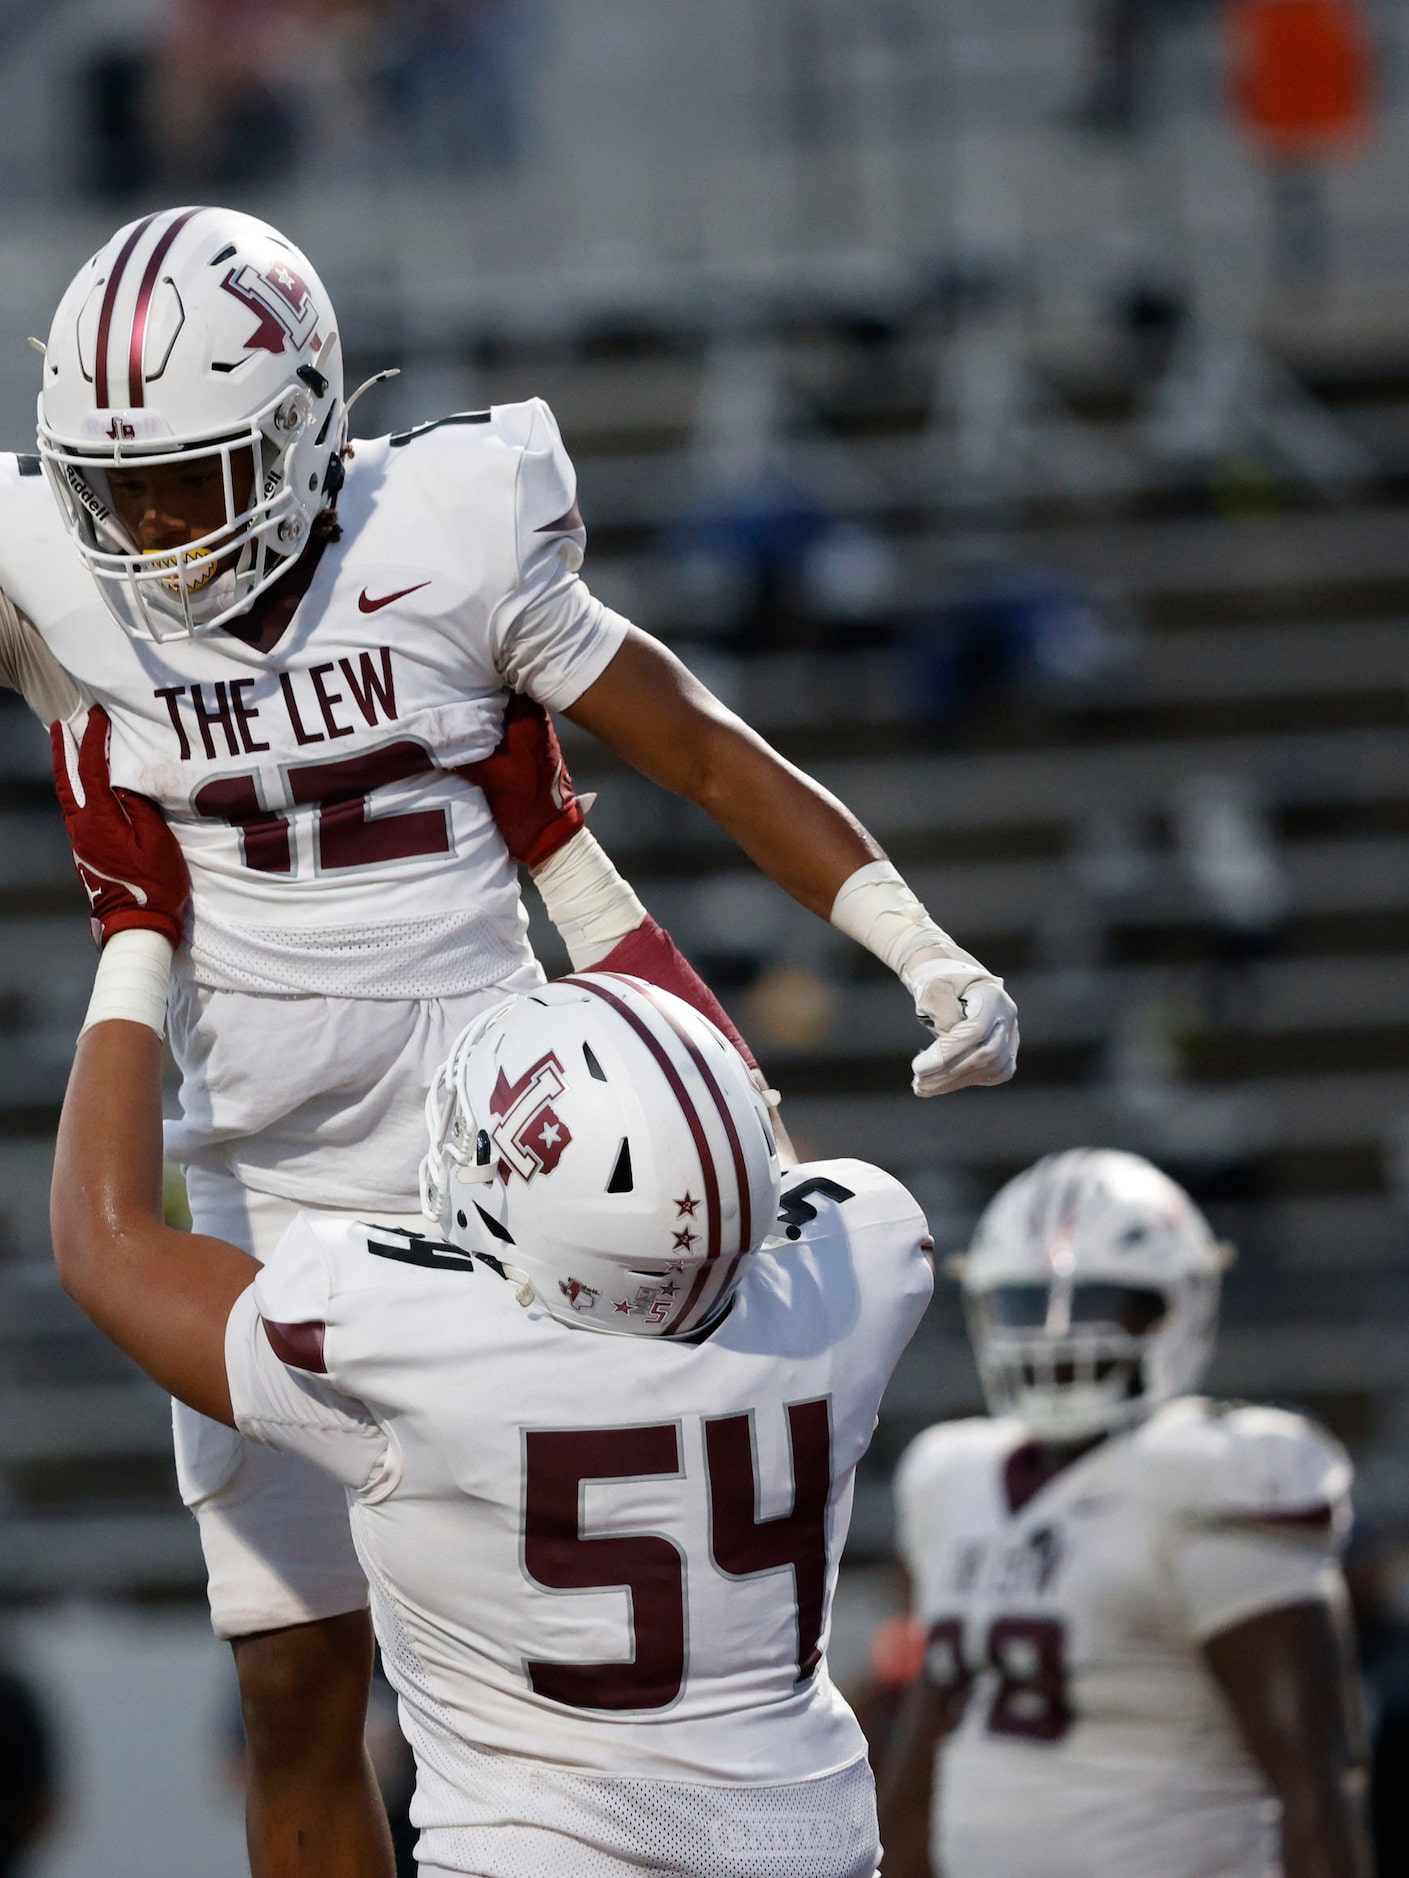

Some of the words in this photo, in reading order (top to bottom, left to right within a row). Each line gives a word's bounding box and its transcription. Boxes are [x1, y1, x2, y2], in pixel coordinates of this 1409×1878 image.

[66, 465, 110, 522] Riddell
[154, 678, 270, 760] THE
[279, 646, 398, 746] LEW
[190, 733, 458, 878] 12
[519, 1392, 833, 1716] 54
